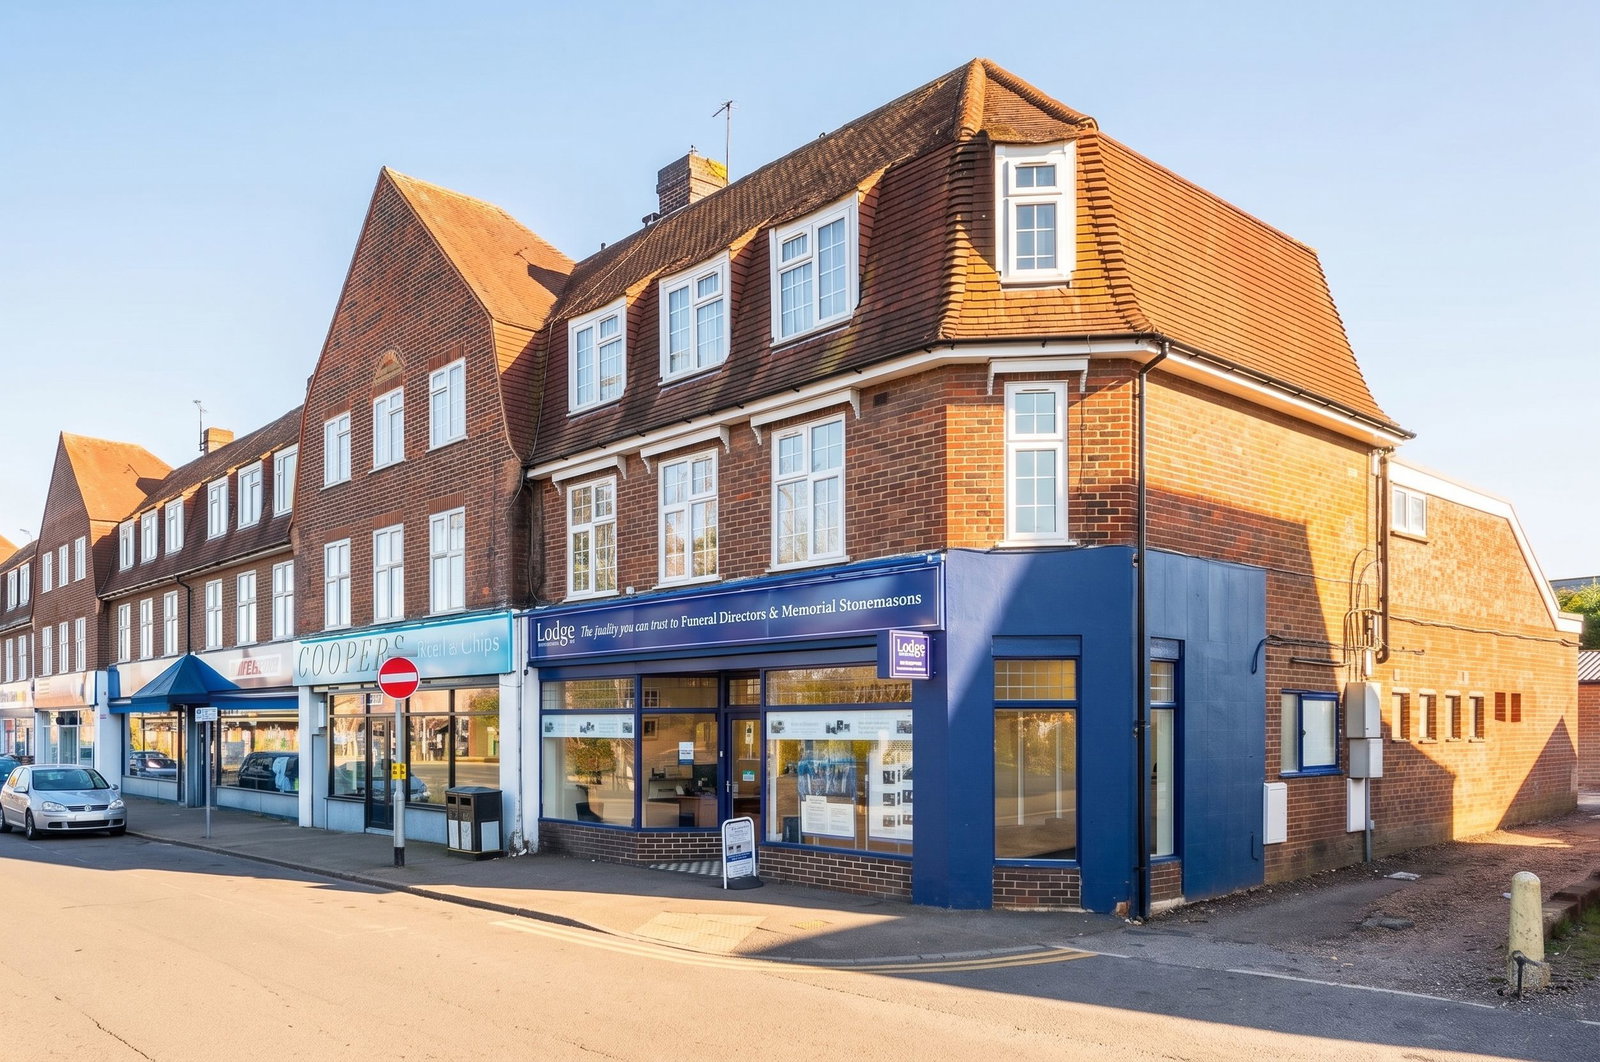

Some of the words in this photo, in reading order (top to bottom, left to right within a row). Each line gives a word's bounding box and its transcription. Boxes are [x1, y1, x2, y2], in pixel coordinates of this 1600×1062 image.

[581, 625, 593, 638] The
[619, 624, 634, 638] you
[635, 622, 649, 632] can
[651, 618, 668, 631] trust
[670, 618, 679, 629] to
[681, 612, 717, 628] Funeral
[719, 609, 767, 624] Directors
[769, 607, 779, 619] &
[781, 600, 836, 618] Memorial
[839, 593, 922, 612] Stonemasons
[537, 620, 575, 647] Lodge
[897, 639, 926, 658] Lodge
